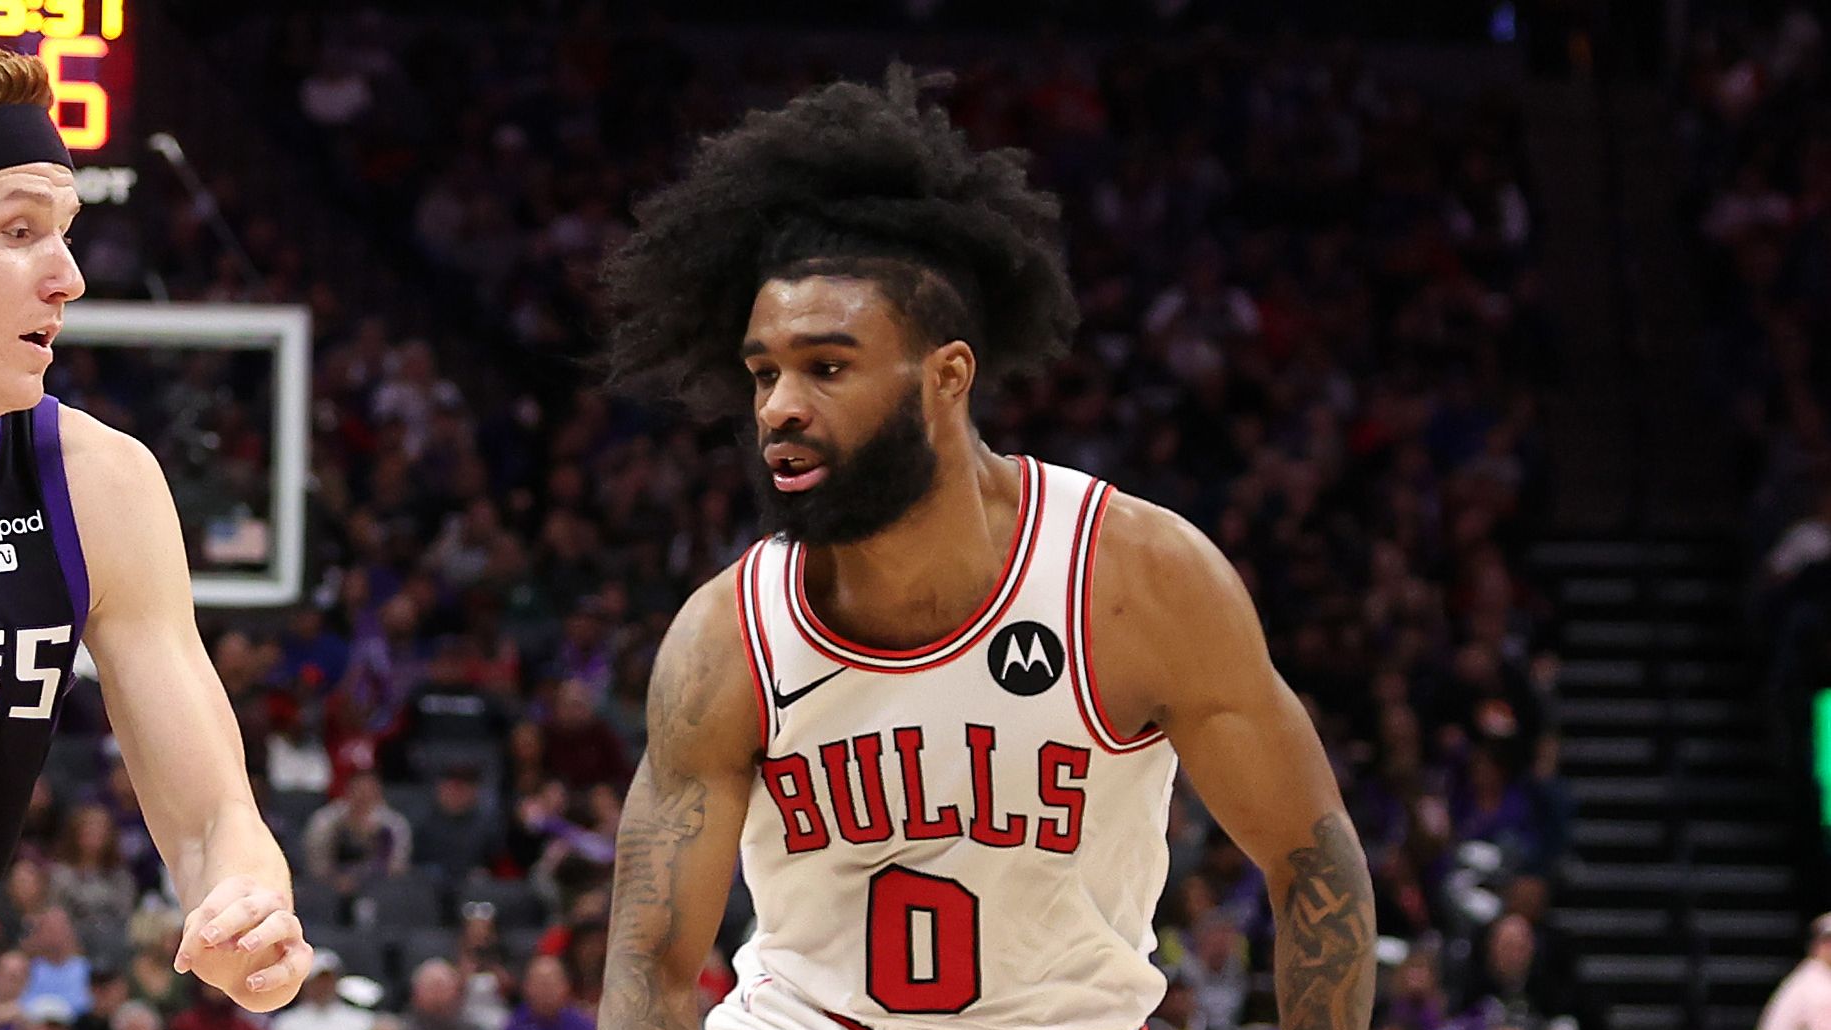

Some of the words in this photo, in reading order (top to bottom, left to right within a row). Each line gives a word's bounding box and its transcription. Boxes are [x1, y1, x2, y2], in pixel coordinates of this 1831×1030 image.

[37, 36, 110, 151] 6
[761, 722, 1091, 855] BULLS
[865, 863, 982, 1015] 0
